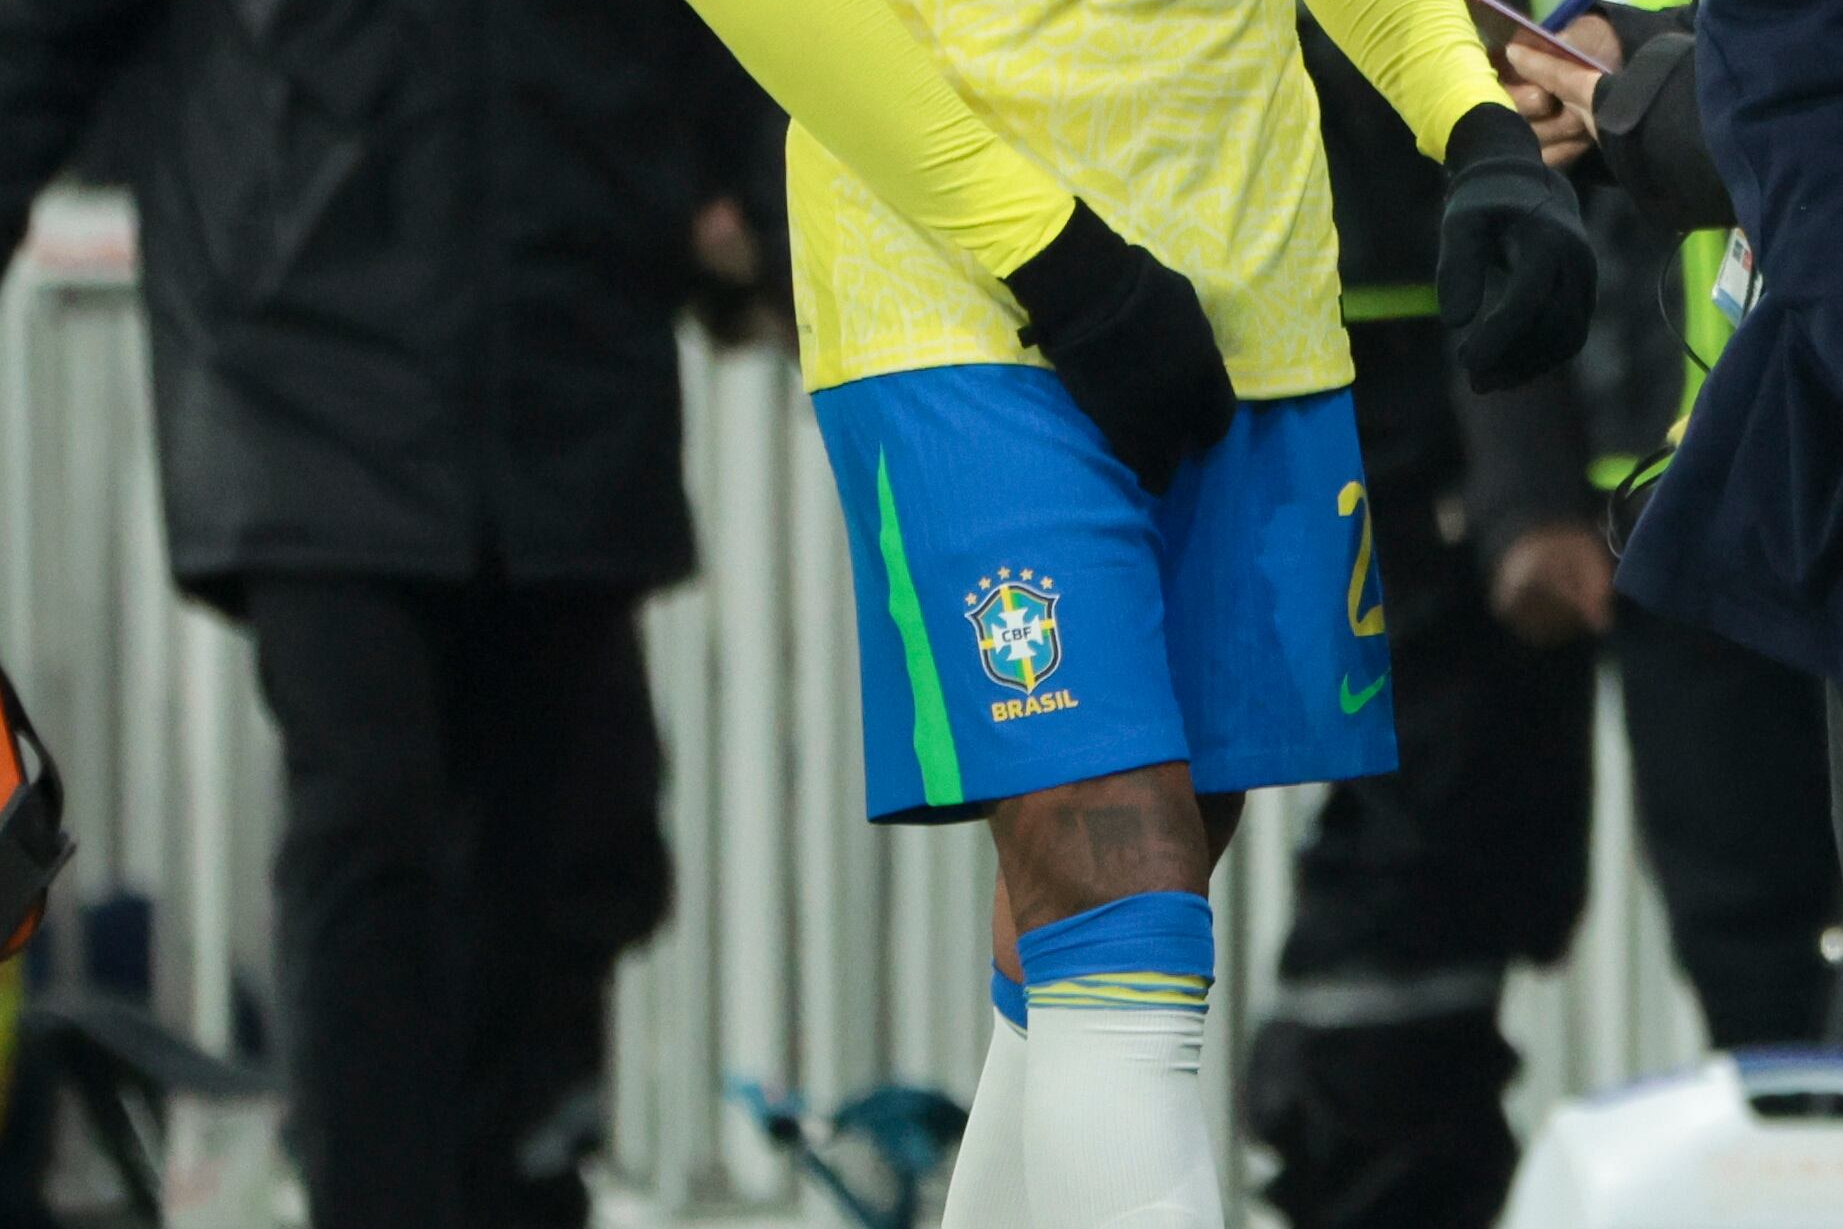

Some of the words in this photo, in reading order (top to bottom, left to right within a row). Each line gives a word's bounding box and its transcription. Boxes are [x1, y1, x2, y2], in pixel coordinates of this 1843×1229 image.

[1337, 481, 1385, 637] 2
[1001, 626, 1032, 643] CBF
[991, 689, 1079, 723] BRASIL
